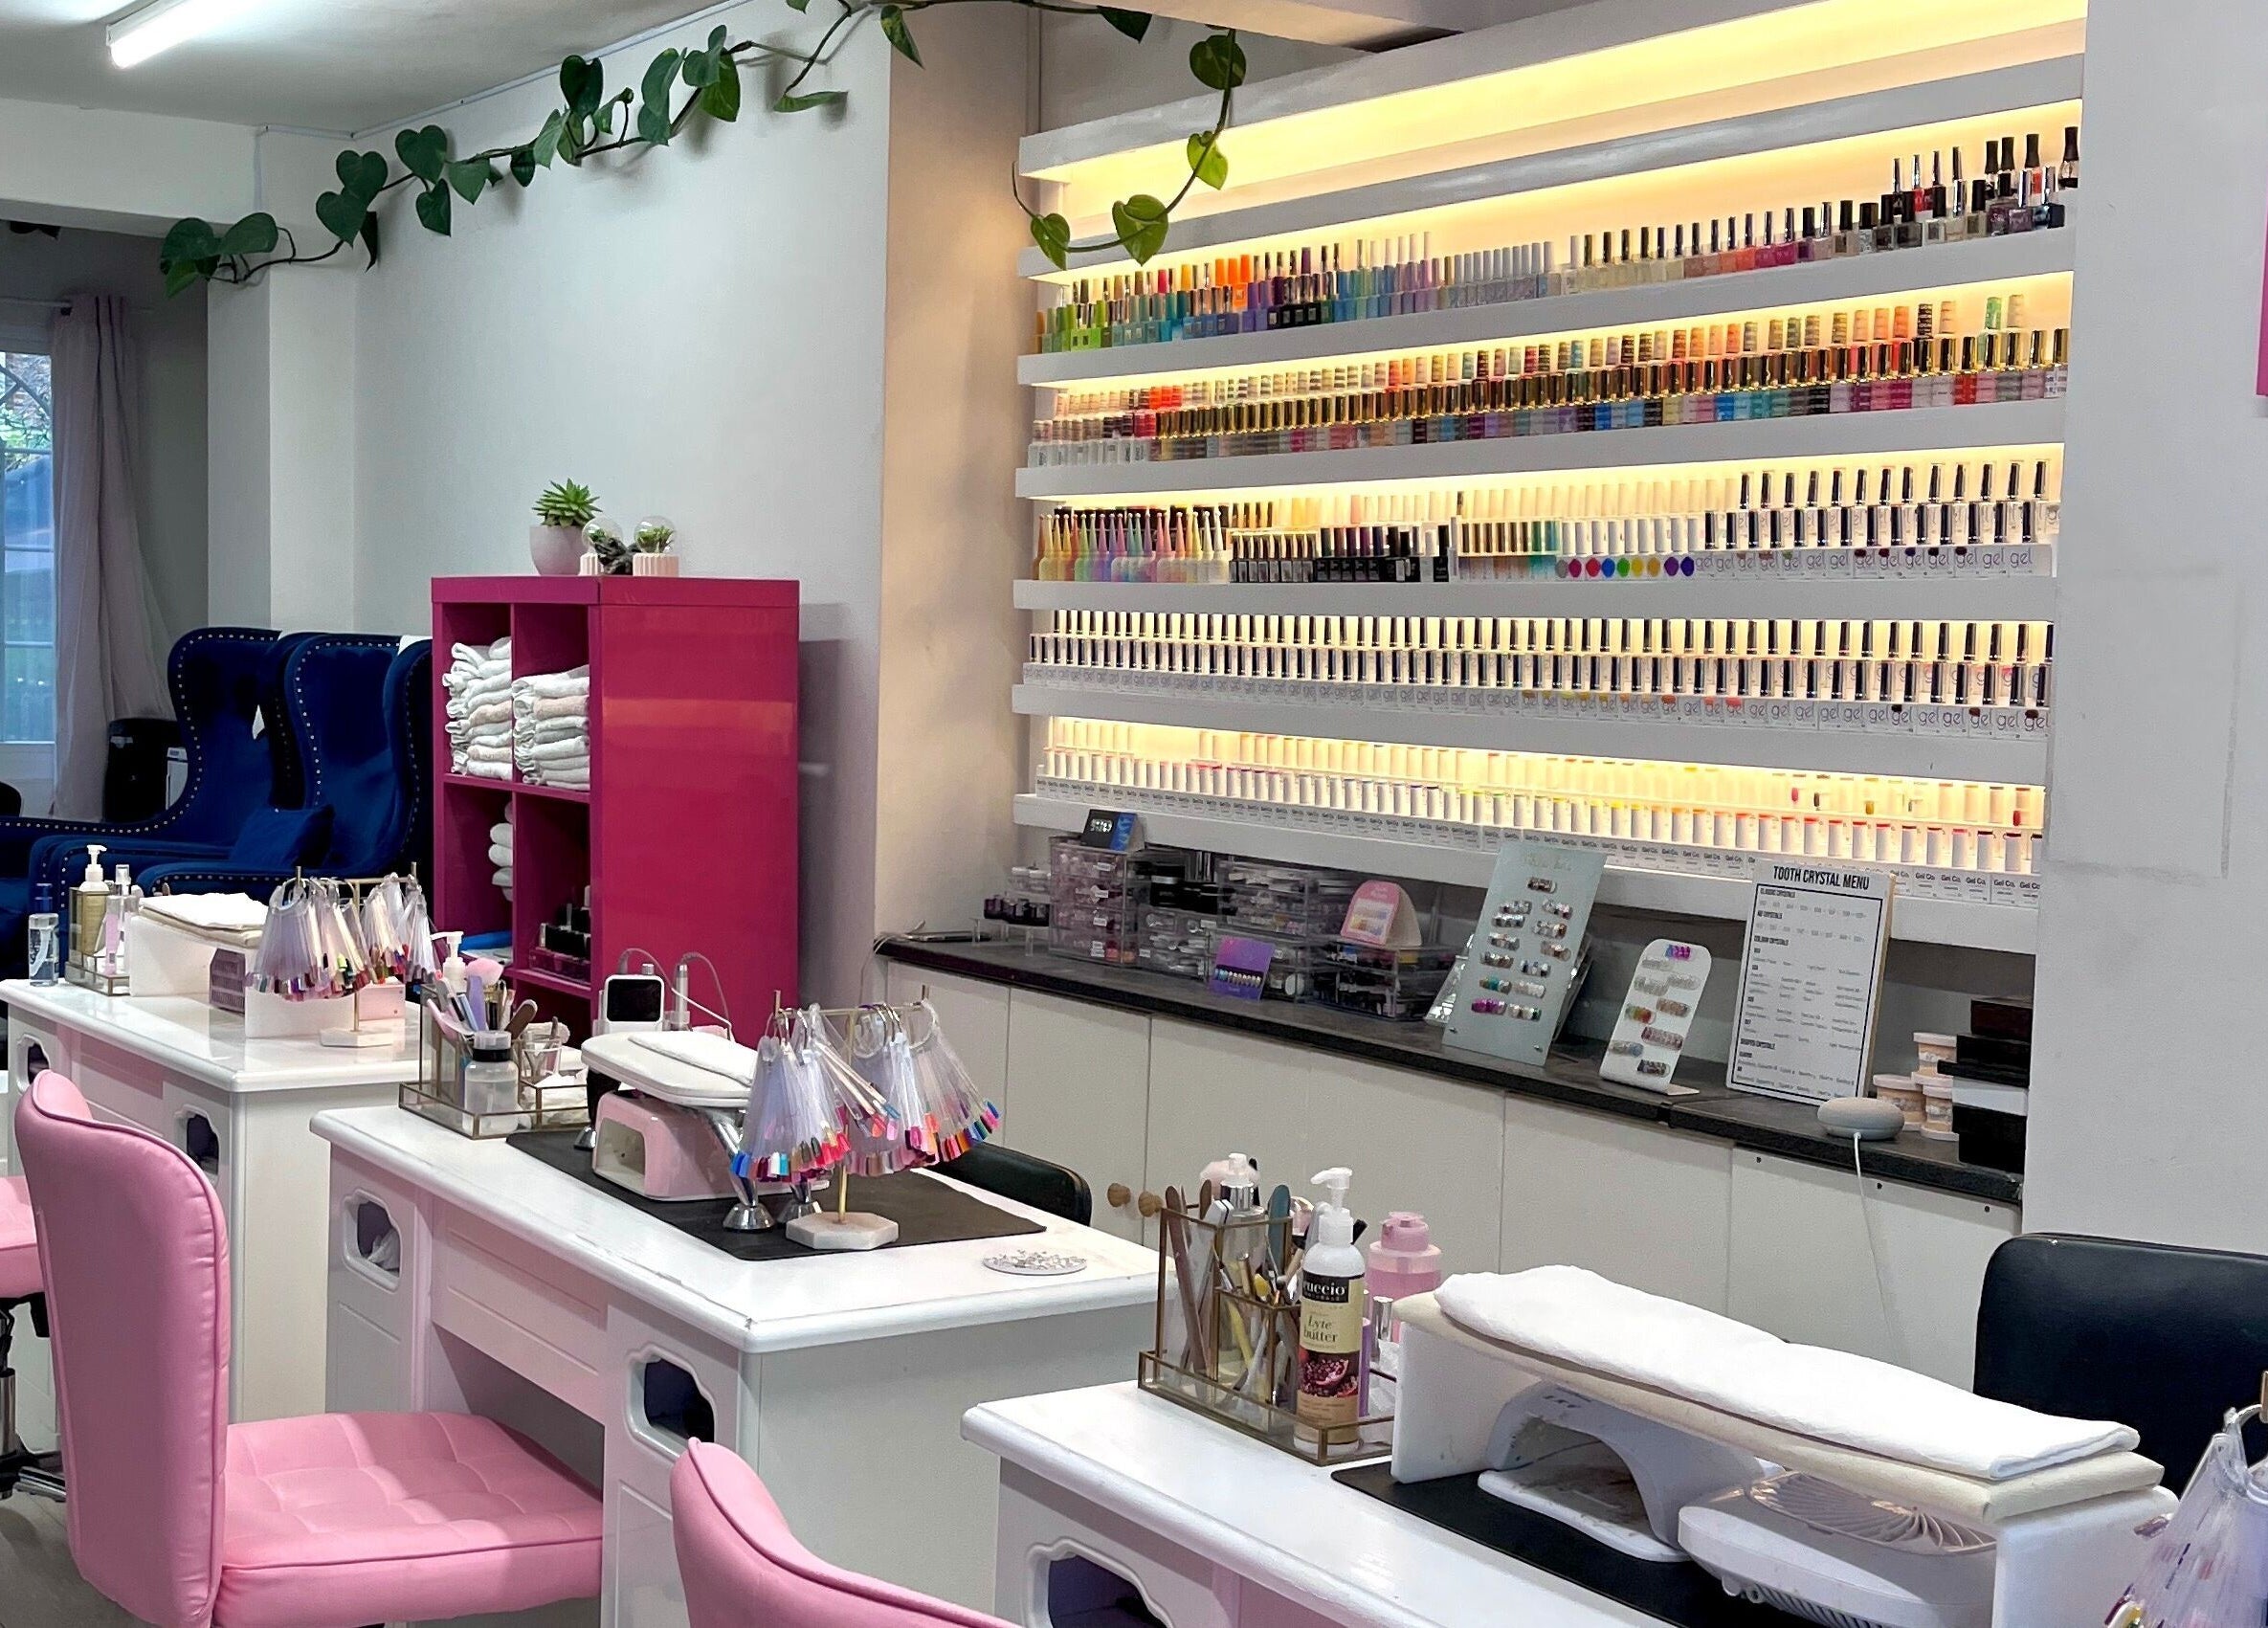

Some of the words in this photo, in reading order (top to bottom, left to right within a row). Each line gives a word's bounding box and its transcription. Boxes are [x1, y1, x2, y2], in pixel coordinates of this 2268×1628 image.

[1716, 551, 1734, 572] gel
[1738, 550, 1756, 569] gel
[1783, 550, 1801, 570] gel
[1807, 549, 1825, 569] gel
[1830, 549, 1850, 569] gel
[1855, 548, 1876, 569] gel
[1879, 548, 1901, 569] gel
[1905, 548, 1925, 569] gel
[1928, 547, 1950, 569] gel
[1956, 546, 1978, 569] gel
[1982, 546, 2005, 569] gel
[2010, 546, 2033, 569] gel
[1771, 701, 1790, 721] gel
[1794, 701, 1814, 721] gel
[1820, 702, 1839, 722] gel
[1843, 702, 1864, 722] gel
[1868, 702, 1889, 724] gel
[1891, 705, 1914, 726] gel
[1918, 706, 1939, 726] gel
[1943, 706, 1967, 728] gel
[1969, 707, 1993, 729] gel
[1996, 710, 2020, 730] gel
[2024, 708, 2049, 731] gel
[1773, 865, 1802, 882] TOOTH
[1803, 869, 1840, 886] CRYSTAL
[1842, 873, 1870, 890] MENU
[2019, 881, 2031, 889] Gel
[1307, 1314, 1332, 1331] Lyte
[1303, 1324, 1339, 1343] butter
